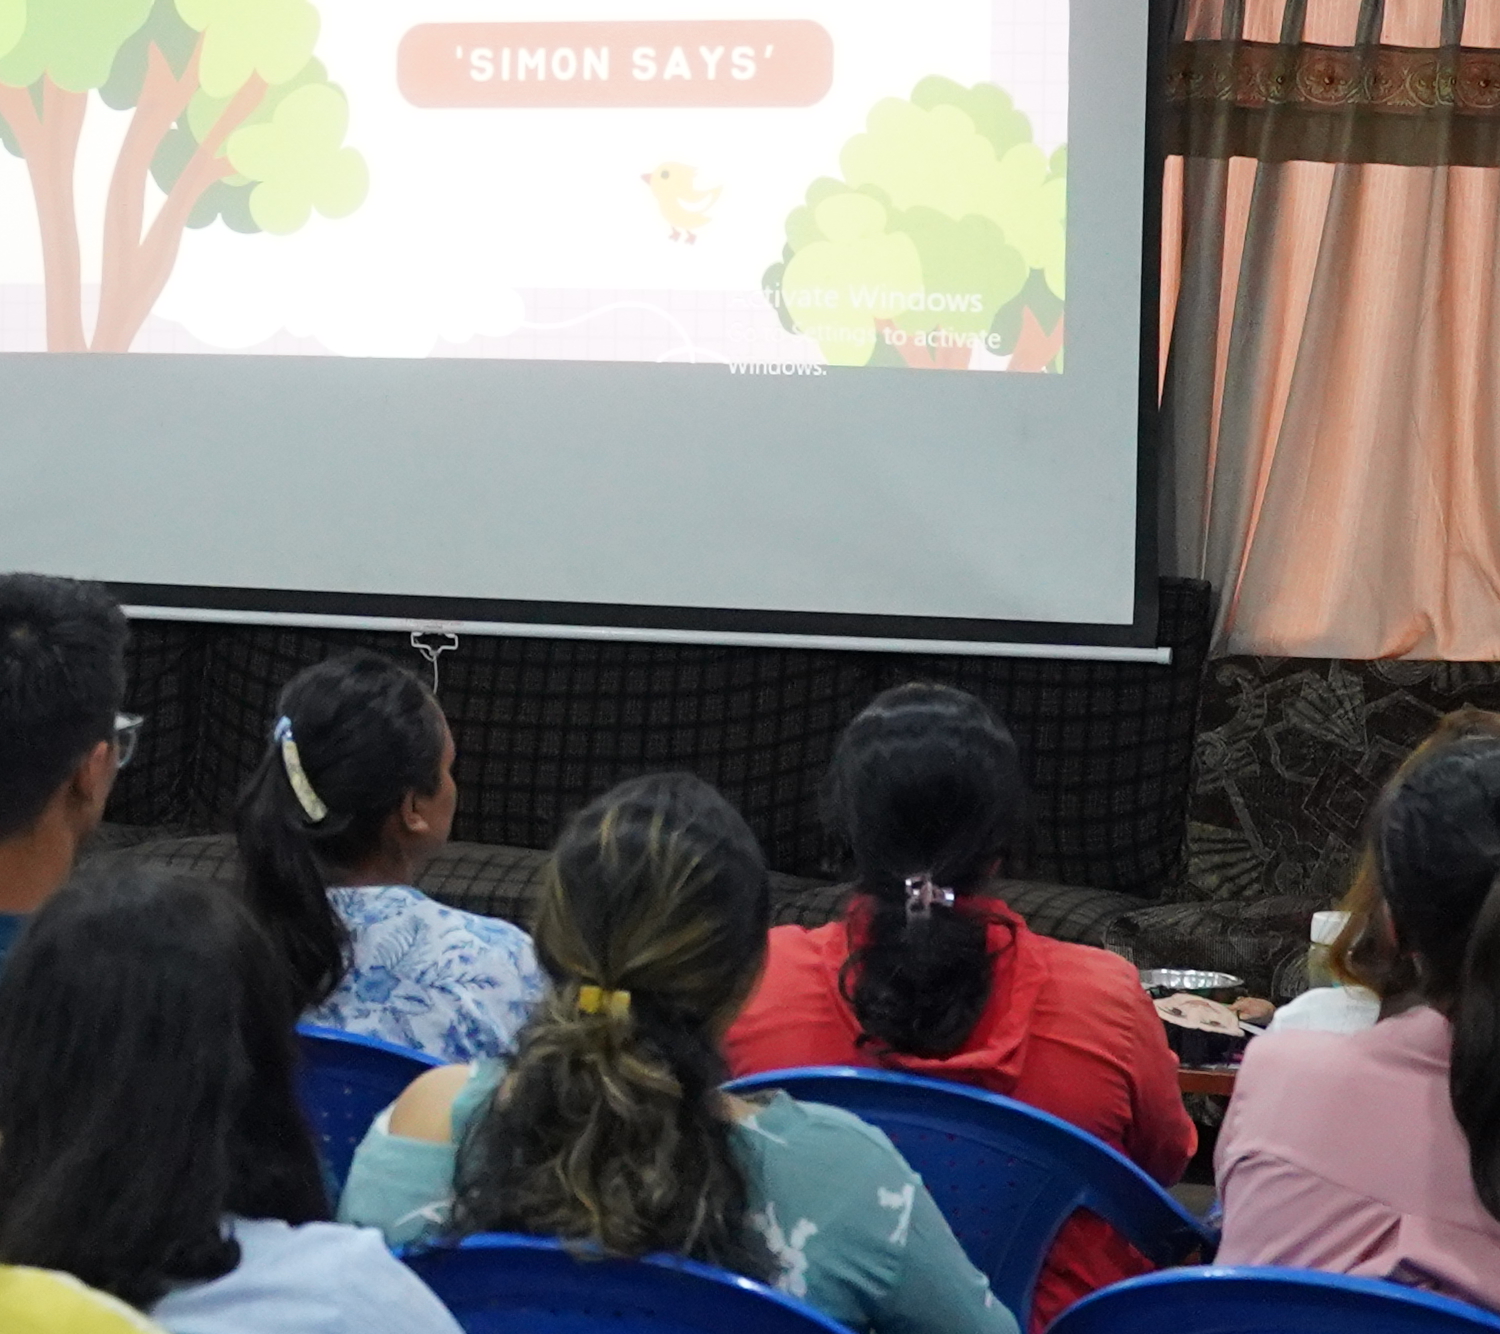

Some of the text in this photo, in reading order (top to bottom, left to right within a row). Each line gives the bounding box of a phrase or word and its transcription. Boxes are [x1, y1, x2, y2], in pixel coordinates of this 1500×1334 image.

[849, 282, 984, 313] Windows
[882, 325, 908, 346] to
[913, 327, 1002, 350] activate
